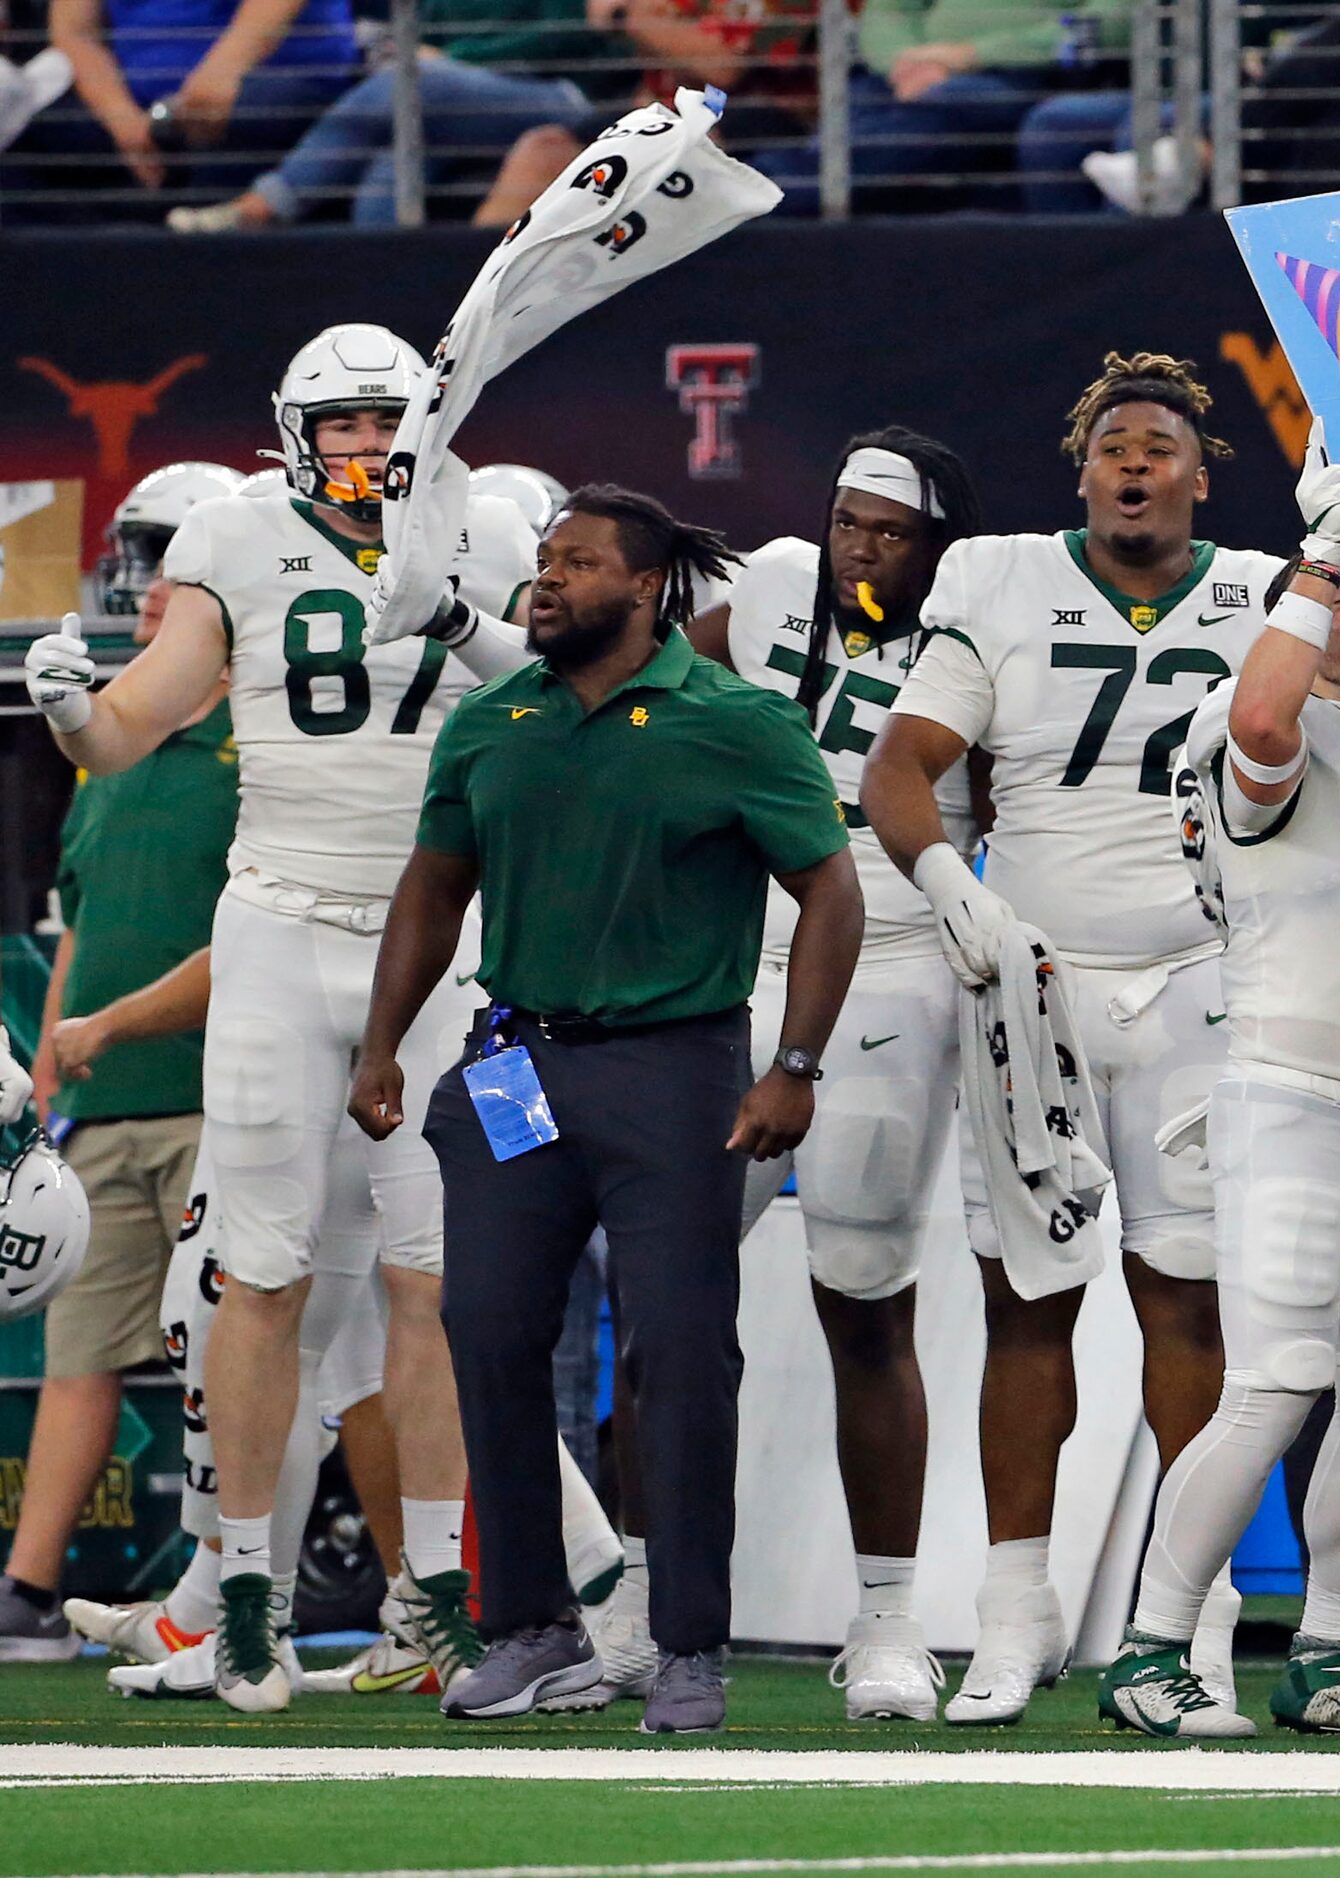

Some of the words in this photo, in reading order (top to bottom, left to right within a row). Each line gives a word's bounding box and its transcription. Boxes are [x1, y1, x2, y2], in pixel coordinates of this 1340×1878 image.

[358, 384, 387, 395] BEARS
[1215, 584, 1247, 601] ONE
[1051, 642, 1232, 796] 72
